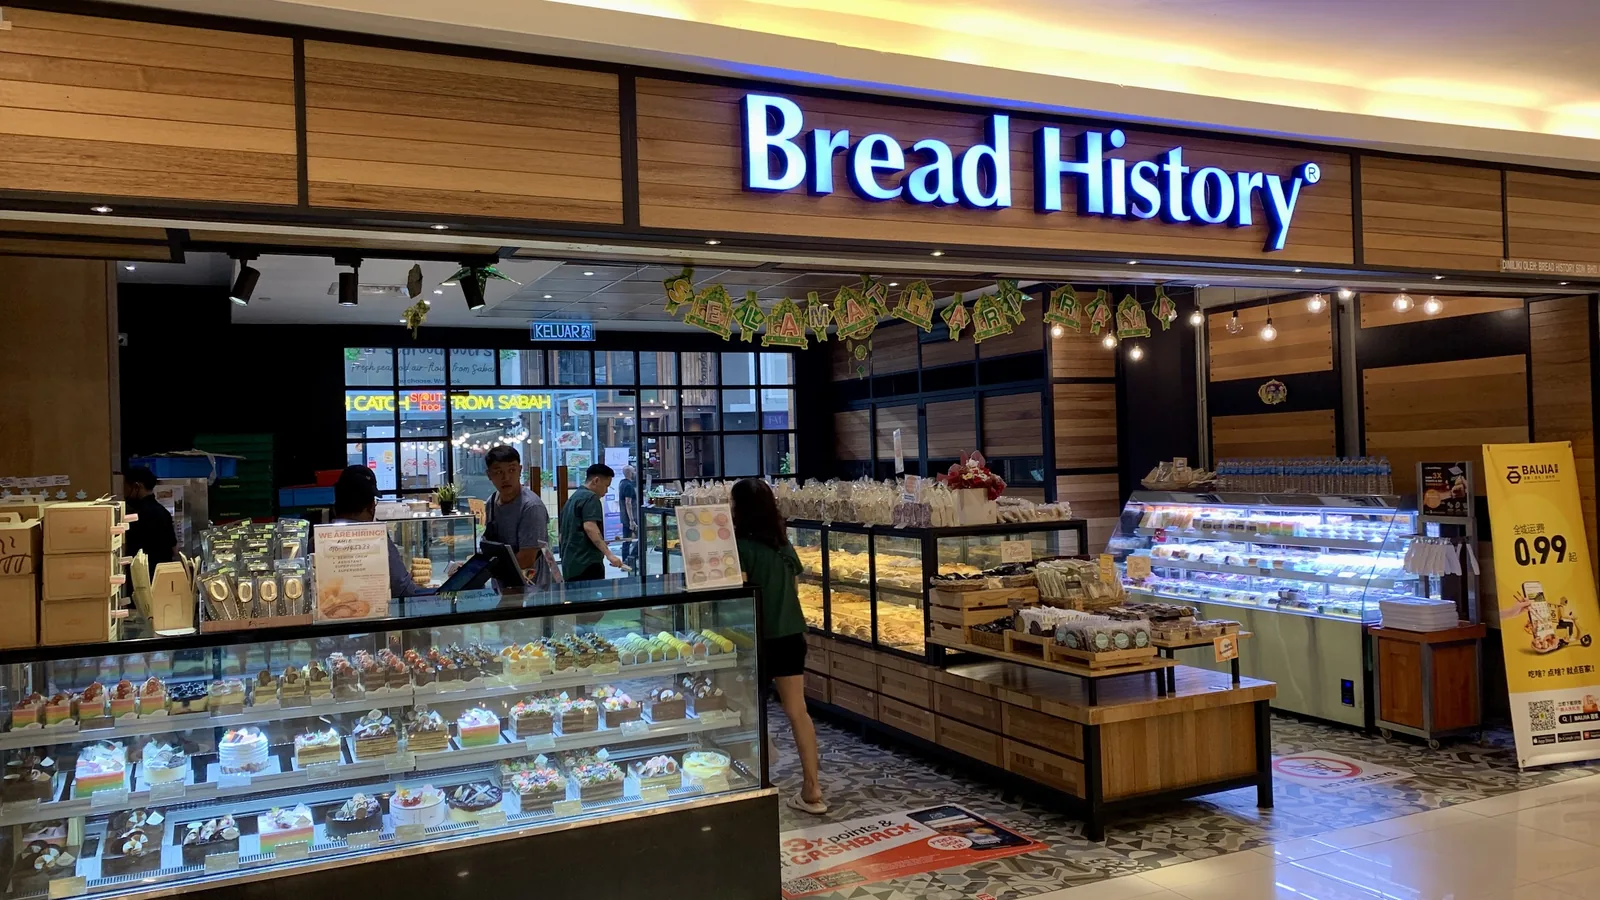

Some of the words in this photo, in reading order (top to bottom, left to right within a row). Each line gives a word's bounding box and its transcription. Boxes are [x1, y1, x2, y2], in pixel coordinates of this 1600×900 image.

[742, 93, 1012, 209] Bread
[1036, 126, 1303, 251] History
[1538, 261, 1554, 272] BREAD
[535, 324, 580, 338] KELUAR
[472, 363, 496, 376] Saba
[353, 396, 410, 412] CATCH
[498, 395, 551, 410] SABAH
[1521, 464, 1555, 475] BAIJIA
[334, 531, 351, 539] ARE
[352, 530, 385, 538] HIRING!!
[1514, 534, 1567, 567] 0.99
[828, 823, 880, 844] points
[790, 822, 920, 865] CASHBACK
